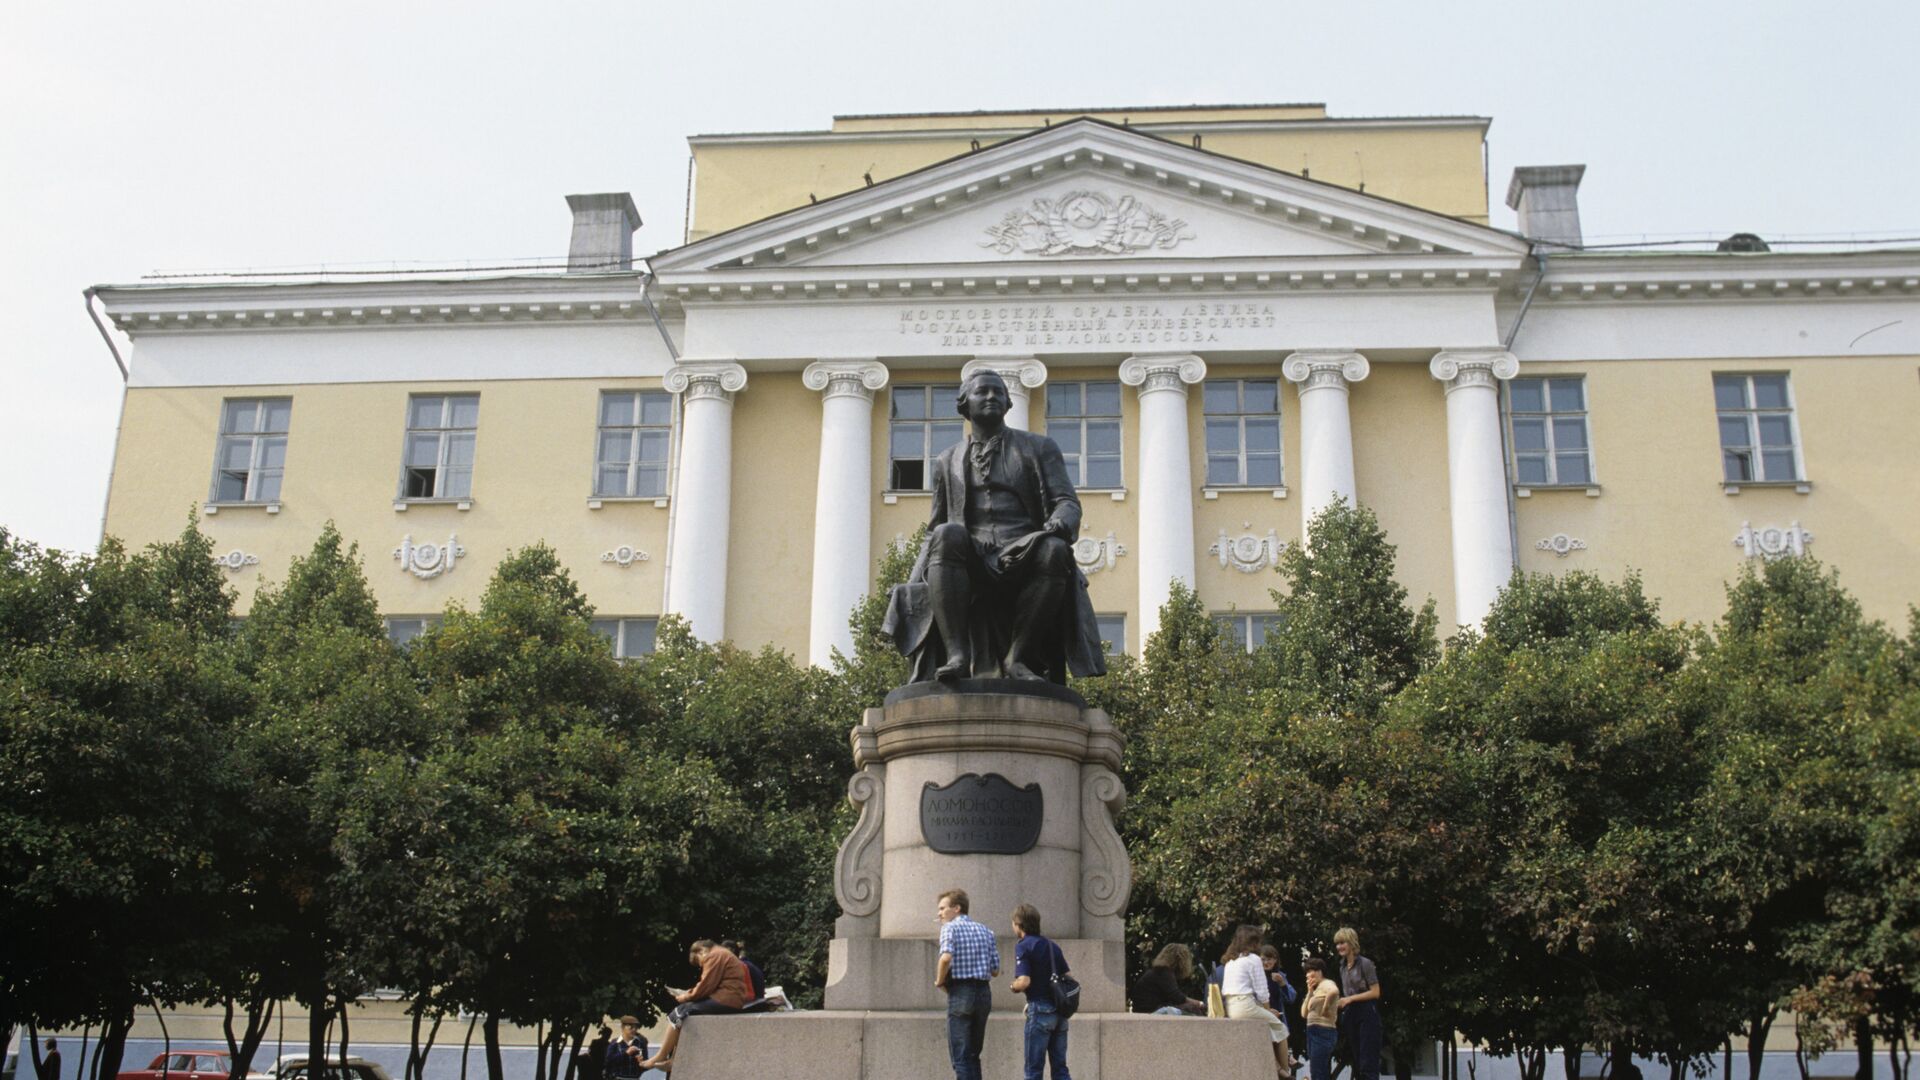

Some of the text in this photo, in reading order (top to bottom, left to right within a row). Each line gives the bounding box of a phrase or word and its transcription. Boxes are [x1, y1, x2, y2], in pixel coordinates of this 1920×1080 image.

[900, 303, 1275, 321] МОСКОВСКИЙ ОРДЕНА ЛЕНИНА
[899, 316, 1277, 334] ГОСУДАРСТВЕННЫЙ УНИВЕРСИТЕТ
[942, 334, 1013, 347] ИМЕНИ
[1067, 331, 1219, 345] ЛОМОНОСОВА
[927, 798, 1033, 814] ЛОМОНОСОВ
